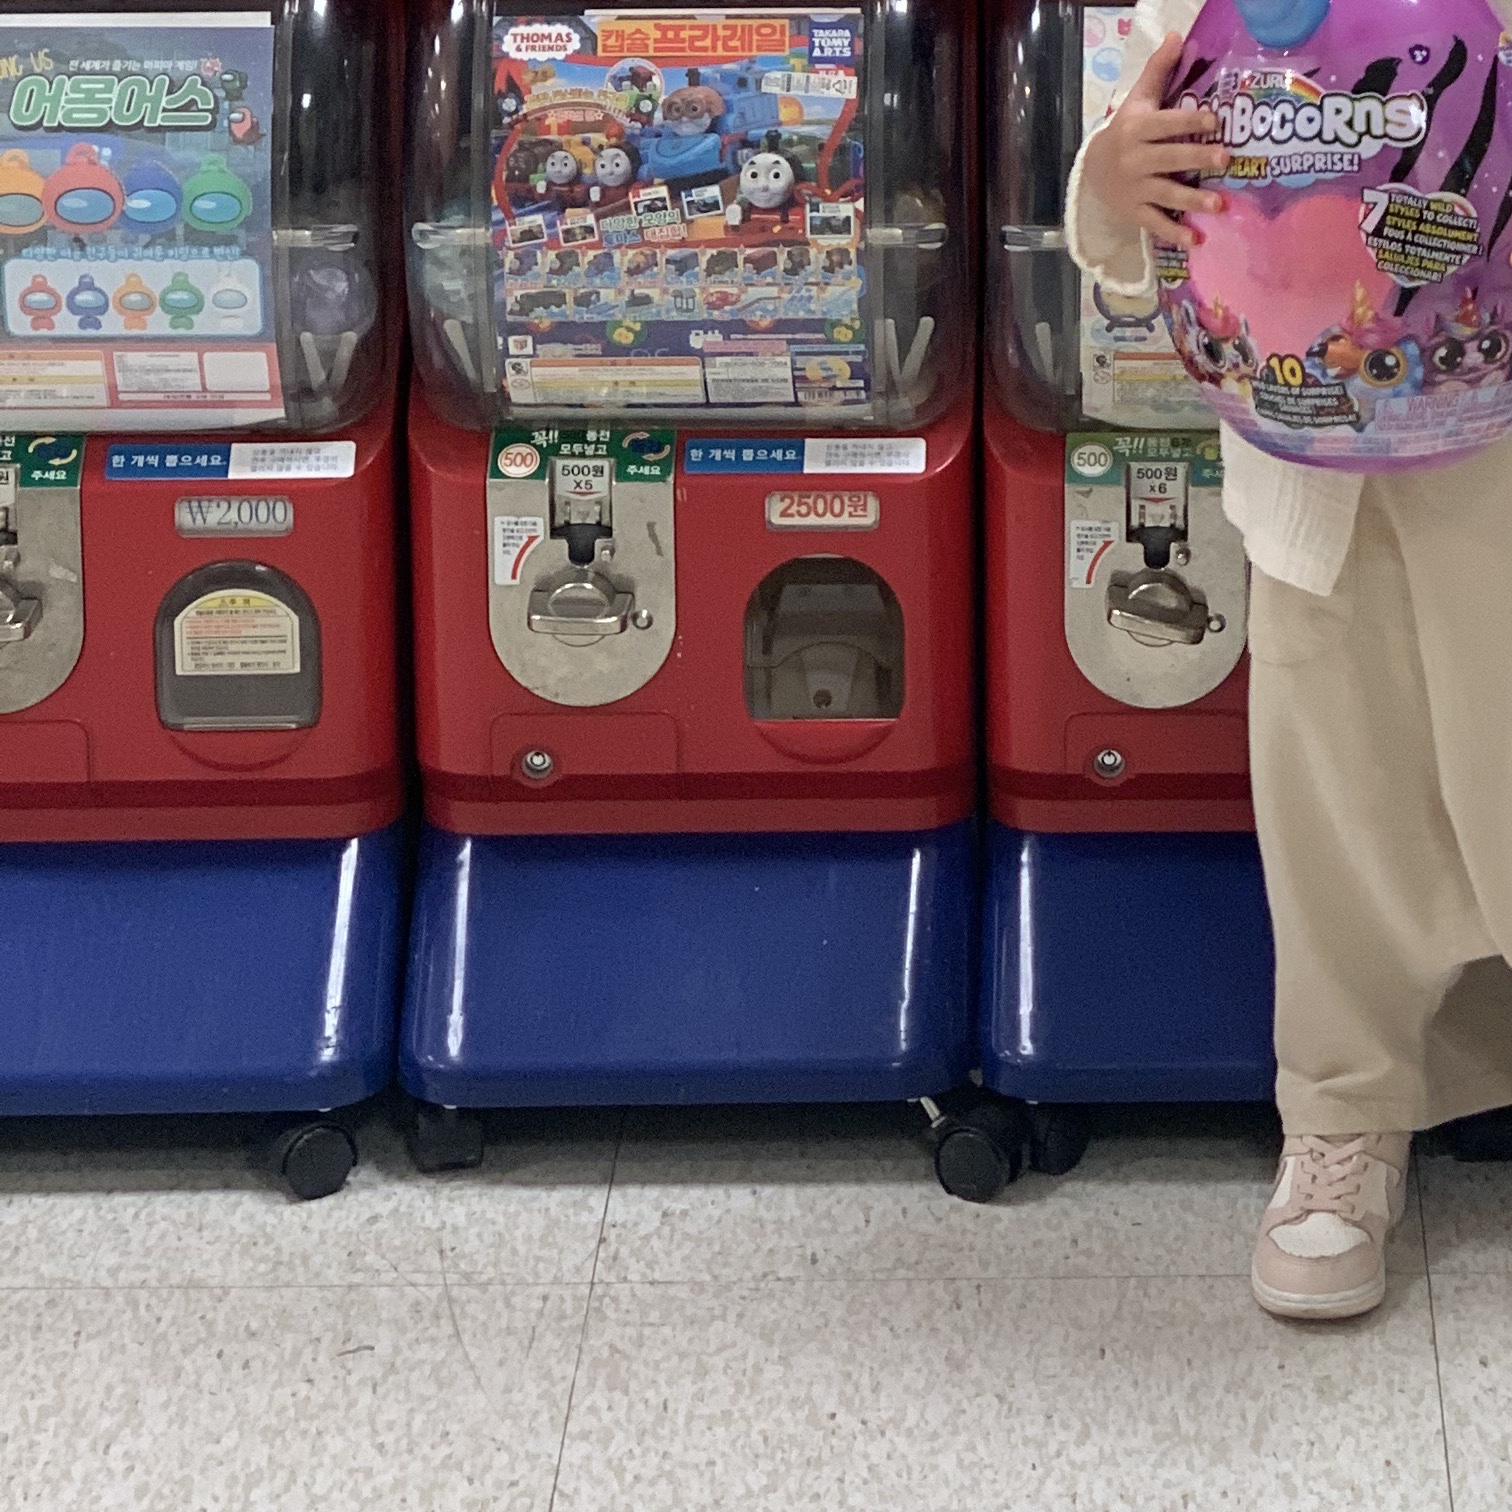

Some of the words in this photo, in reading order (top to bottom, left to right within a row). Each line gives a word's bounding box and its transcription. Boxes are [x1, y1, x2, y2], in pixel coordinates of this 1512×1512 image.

[510, 32, 573, 45] THOMAS
[599, 28, 651, 54] 캡슐
[652, 22, 787, 55] 프라레일
[811, 27, 852, 38] TAKARA
[524, 42, 569, 54] FRIENDS
[811, 37, 852, 48] TOMY
[30, 48, 54, 73] US
[9, 74, 215, 128] 어몽어스
[1230, 155, 1267, 178] HEART
[1270, 152, 1360, 176] SURPRISE!
[1390, 193, 1429, 209] TOTALLY
[1360, 188, 1390, 235] 7
[1422, 210, 1435, 221] TO
[1436, 213, 1478, 229] COLLECT!
[1270, 355, 1304, 387] 10
[111, 454, 126, 467] 한
[130, 454, 160, 468] 개씩
[503, 451, 535, 468] 500
[689, 447, 703, 462] 한
[708, 447, 737, 462] 개씩
[1075, 451, 1109, 468] 500
[30, 469, 68, 481] 주세요
[561, 464, 605, 478] 500원
[1136, 466, 1178, 482] 500원
[778, 493, 870, 519] 2500원
